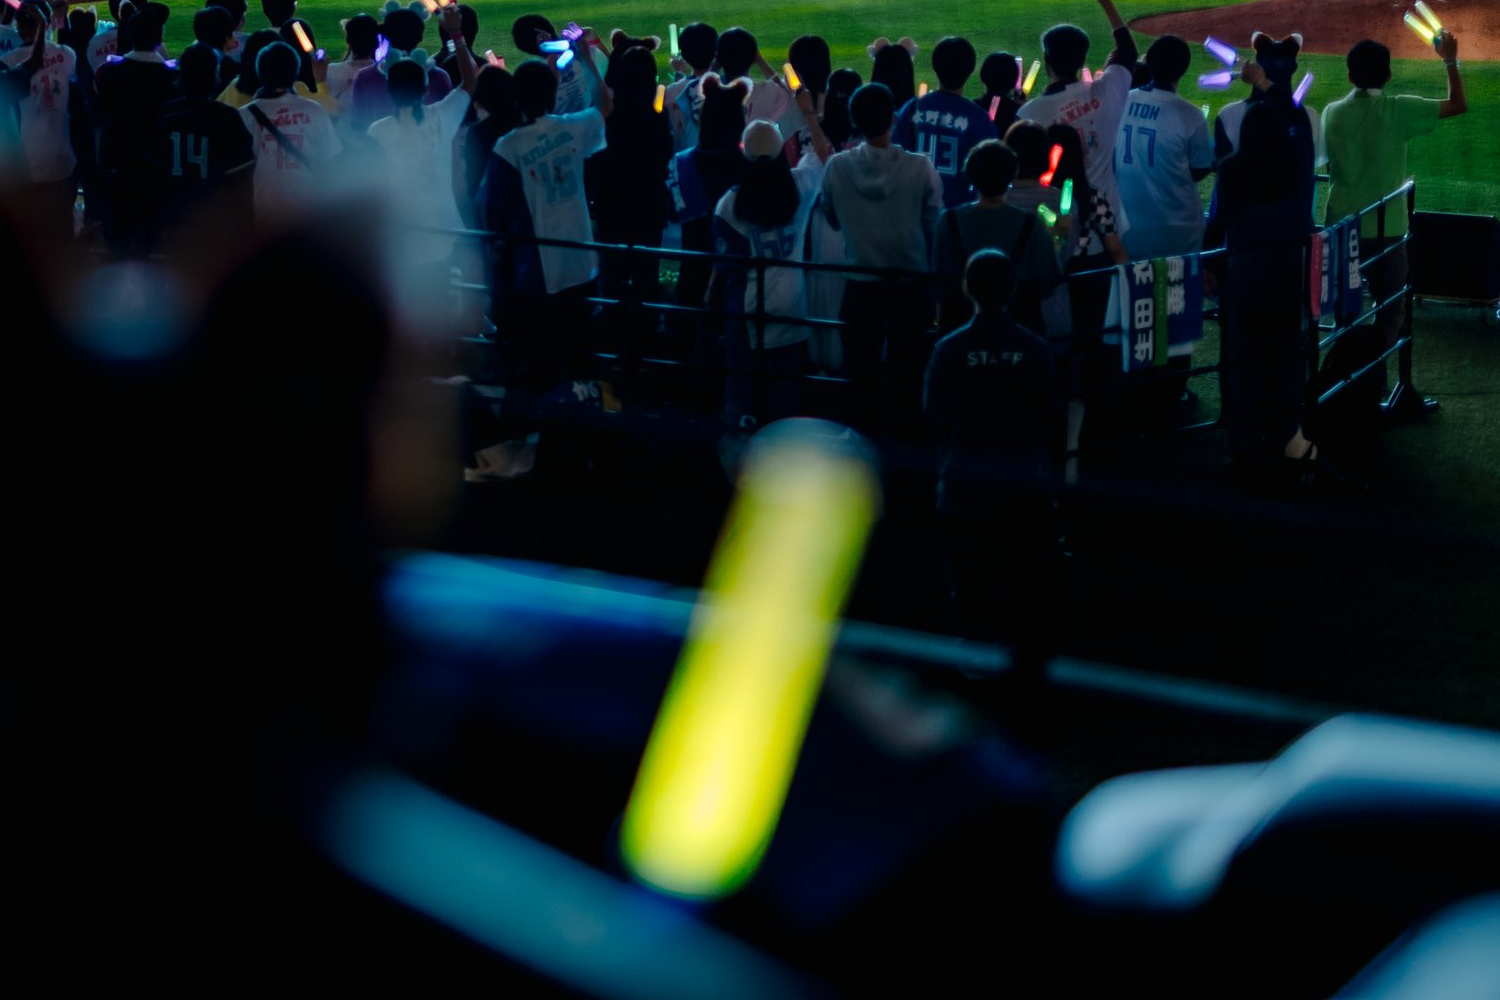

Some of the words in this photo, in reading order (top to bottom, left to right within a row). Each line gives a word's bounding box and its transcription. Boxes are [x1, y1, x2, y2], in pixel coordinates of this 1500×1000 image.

[1128, 101, 1160, 121] ITOH
[170, 131, 210, 180] 14
[1119, 124, 1157, 168] 17
